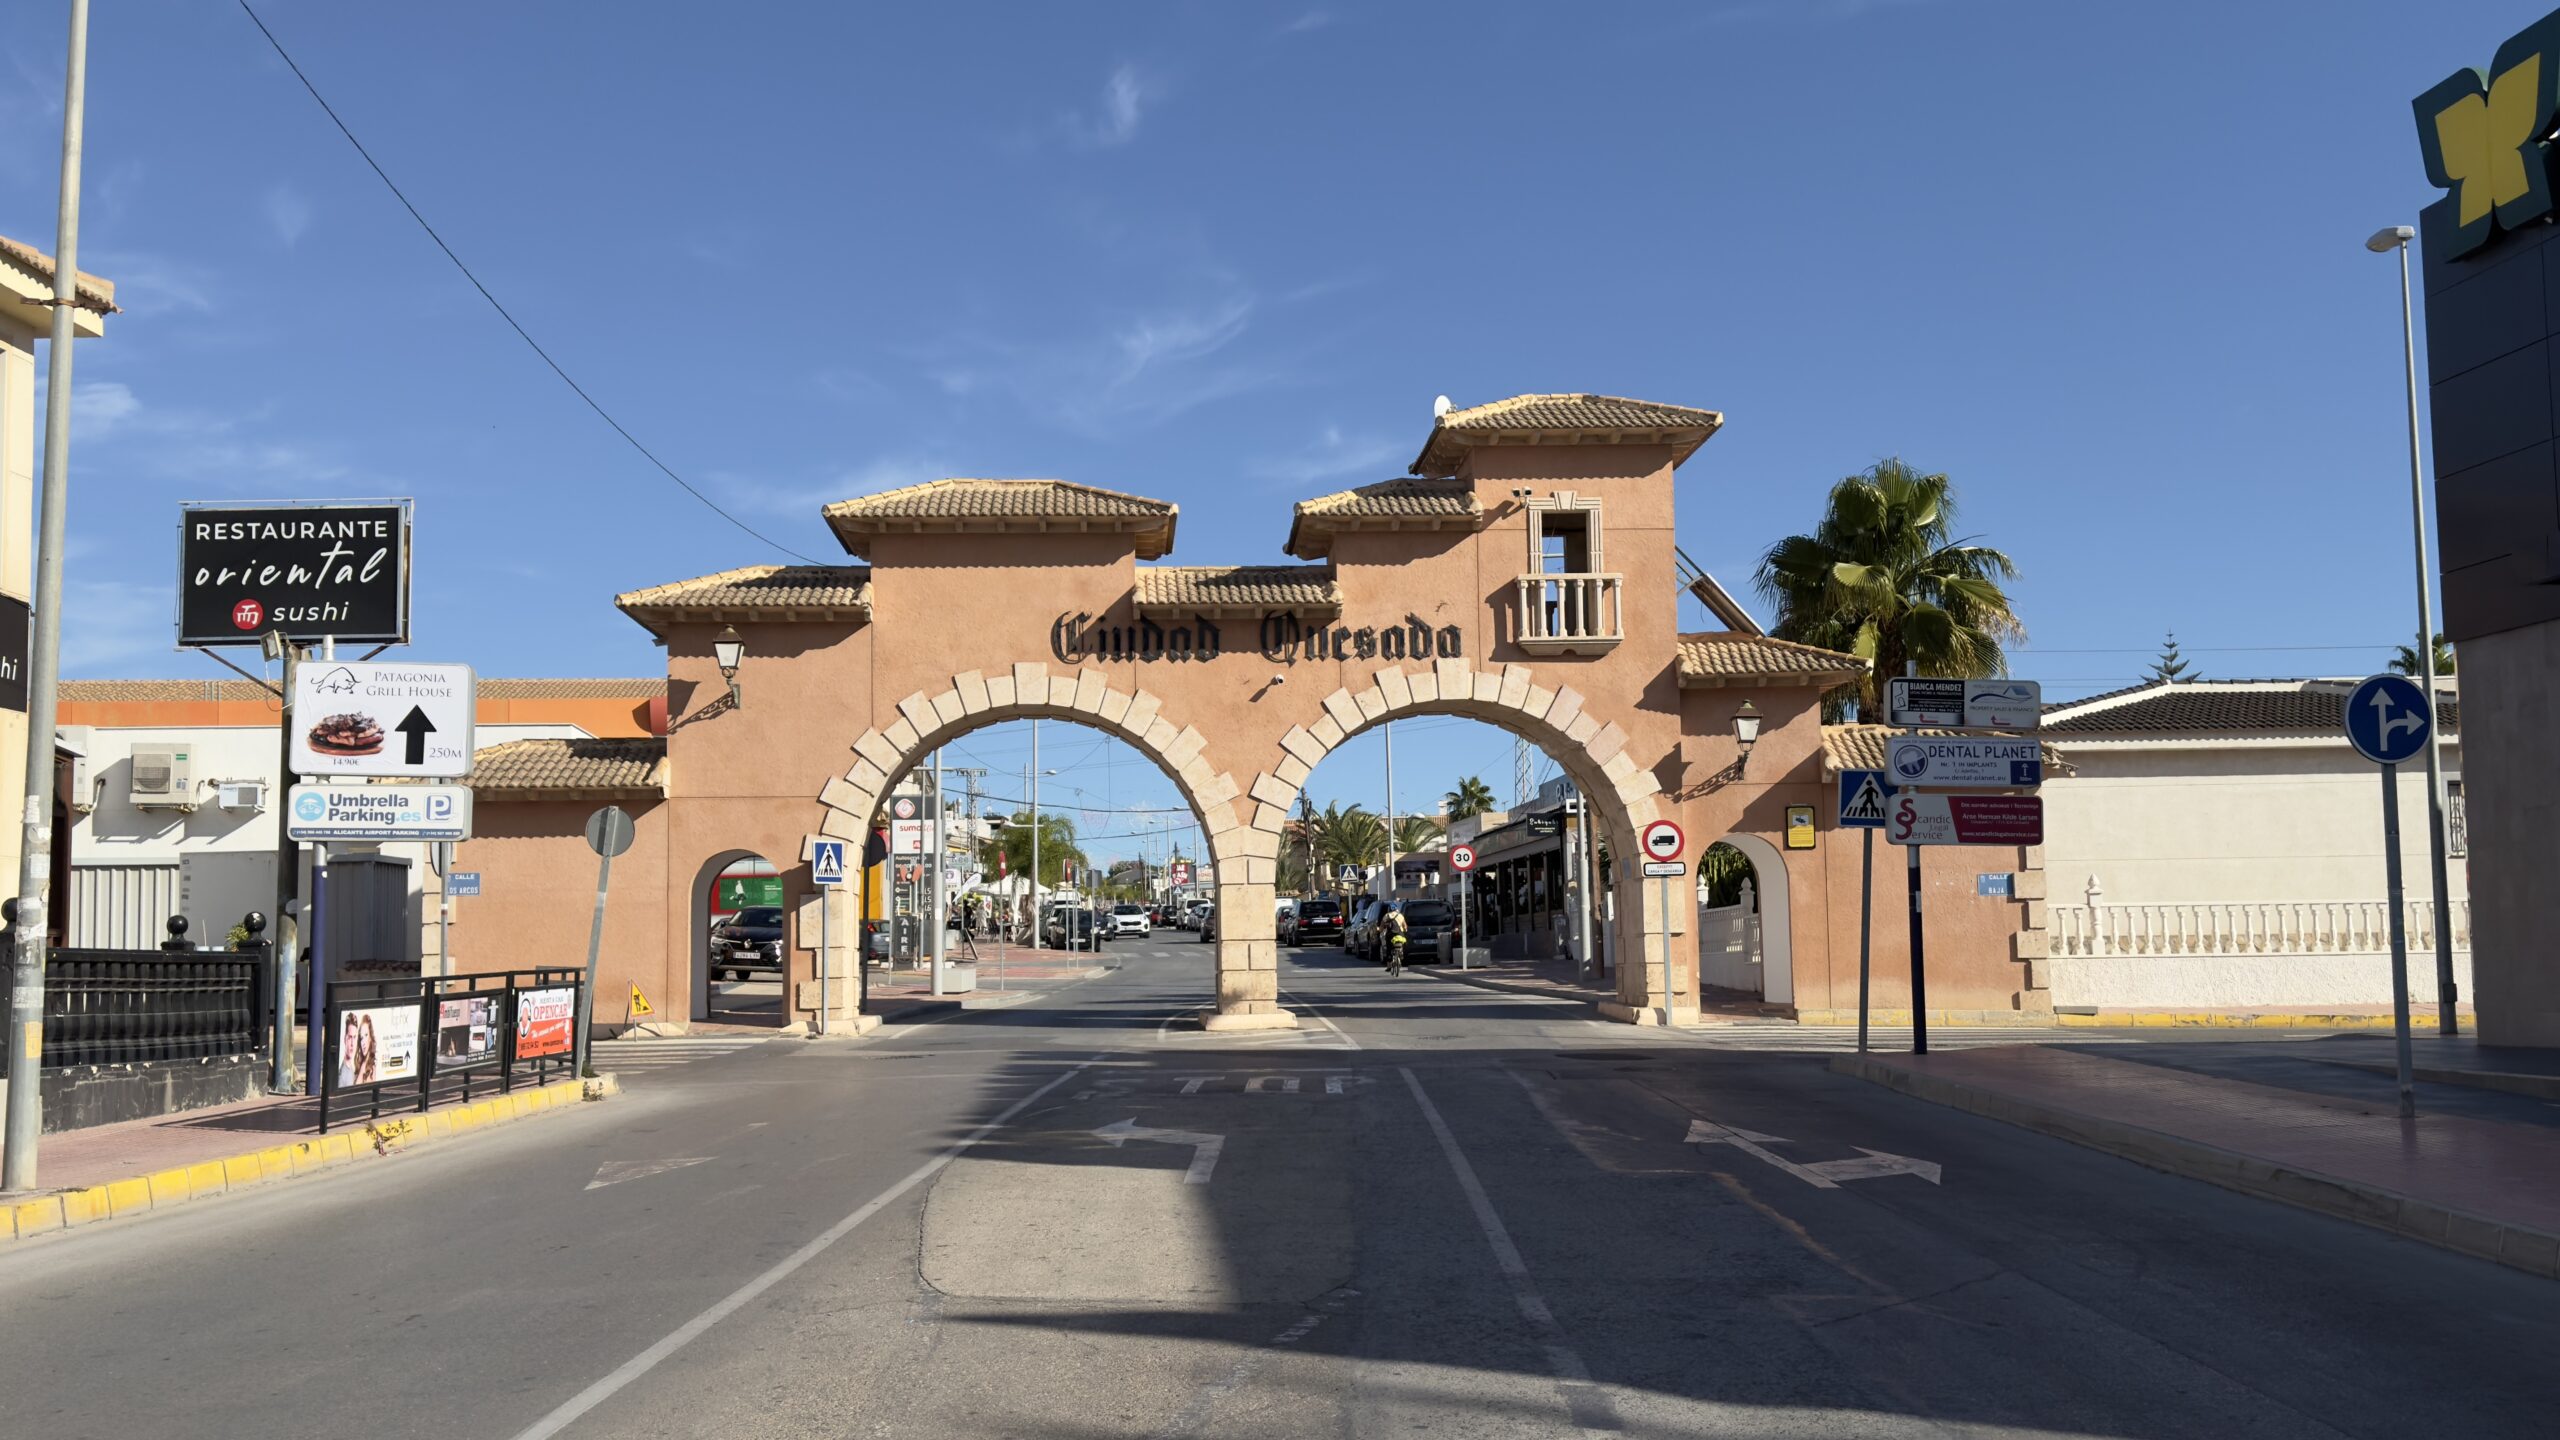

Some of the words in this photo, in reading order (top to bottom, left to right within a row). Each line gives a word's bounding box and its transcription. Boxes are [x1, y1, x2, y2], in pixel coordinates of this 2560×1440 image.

[196, 520, 388, 540] RESTAURANTE
[195, 541, 388, 589] oriental
[272, 601, 349, 621] sushi
[1049, 610, 1220, 665] Ciudad
[1259, 609, 1463, 668] Quesada
[374, 671, 446, 683] PATAGONIA
[366, 686, 402, 697] GRILL
[408, 686, 453, 698] HOUSE
[1909, 682, 1934, 691] BIANCA
[1935, 683, 1963, 692] MENDEZ
[1929, 745, 1980, 759] DENTAL
[1984, 745, 2037, 759] PLANET
[333, 758, 361, 767] 14.90€
[328, 793, 409, 808] Umbrella
[328, 808, 421, 826] Parking.es
[1455, 853, 1470, 862] 30
[459, 886, 478, 894] ARCOS
[900, 917, 909, 954] AIRE
[533, 1002, 568, 1020] OPENCAR
